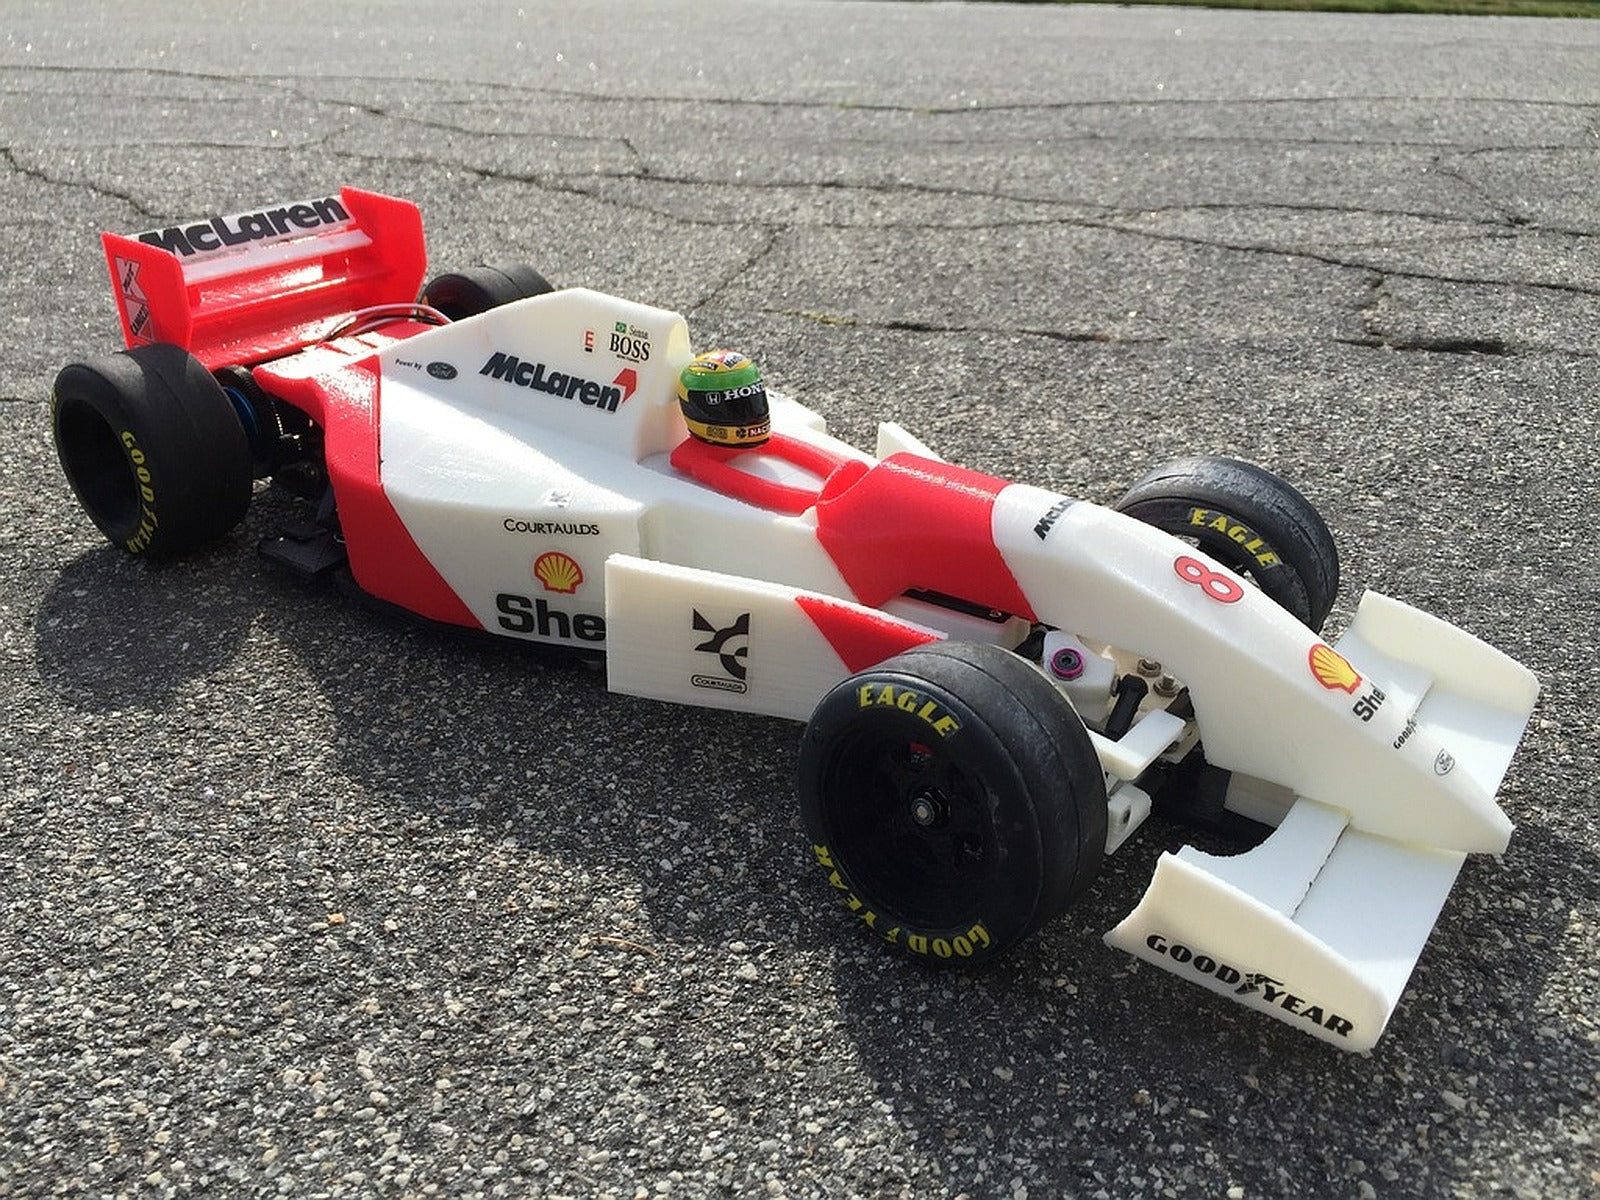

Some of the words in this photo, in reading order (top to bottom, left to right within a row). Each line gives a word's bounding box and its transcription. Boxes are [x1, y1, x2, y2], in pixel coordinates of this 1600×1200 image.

[139, 197, 350, 257] McLaren
[609, 333, 652, 361] BOSS
[479, 352, 623, 413] McLaren
[724, 382, 766, 401] HON
[503, 518, 600, 536] COURTAULDS
[1190, 508, 1281, 568] EAGLE
[1174, 555, 1244, 604] 8
[496, 593, 607, 642] She
[859, 684, 960, 738] EAGLE
[1352, 682, 1386, 722] She
